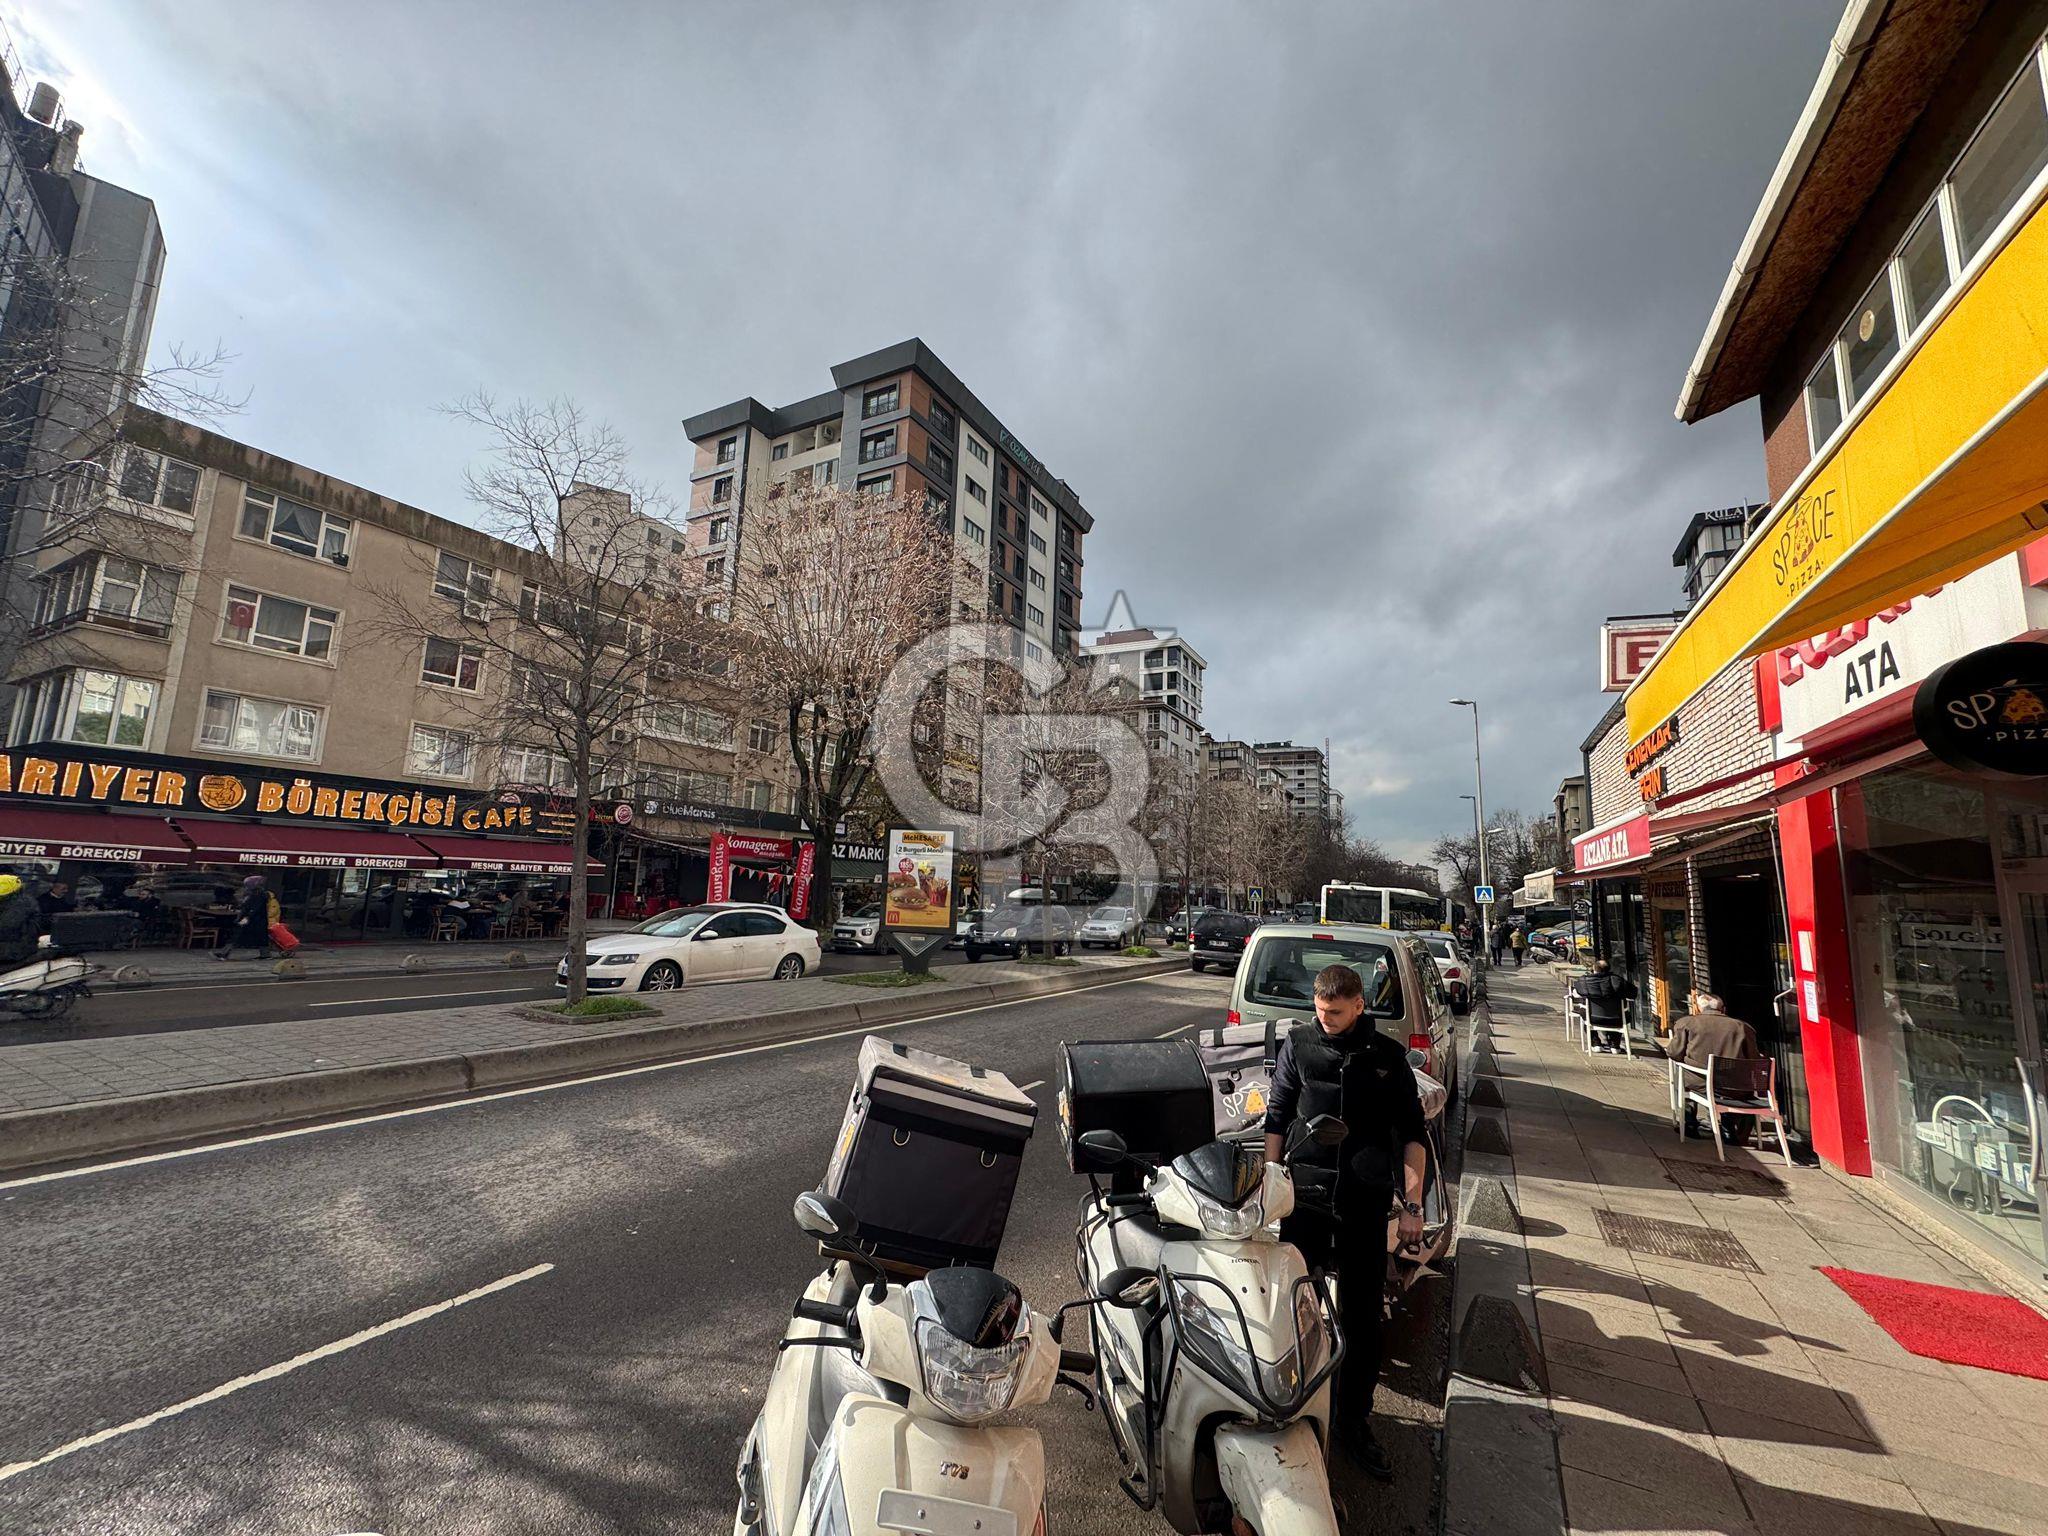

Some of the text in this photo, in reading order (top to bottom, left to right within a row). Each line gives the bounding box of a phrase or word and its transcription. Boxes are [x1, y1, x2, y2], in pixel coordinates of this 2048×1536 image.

[1704, 507, 1744, 521] KULA
[1845, 640, 1900, 704] ATA
[257, 778, 456, 826] BÖREKÇİSİ
[462, 805, 533, 830] CAFE
[60, 845, 143, 861] BÖREKÇİSİ
[728, 836, 779, 853] komagene
[1583, 829, 1629, 867] ECZANE ATA
[239, 853, 407, 868] MEŞHUR SARIYER BÖREKÇİSİ
[471, 861, 573, 873] MEŞHUR SARIYER BÖREK
[940, 1461, 970, 1480] TVS
